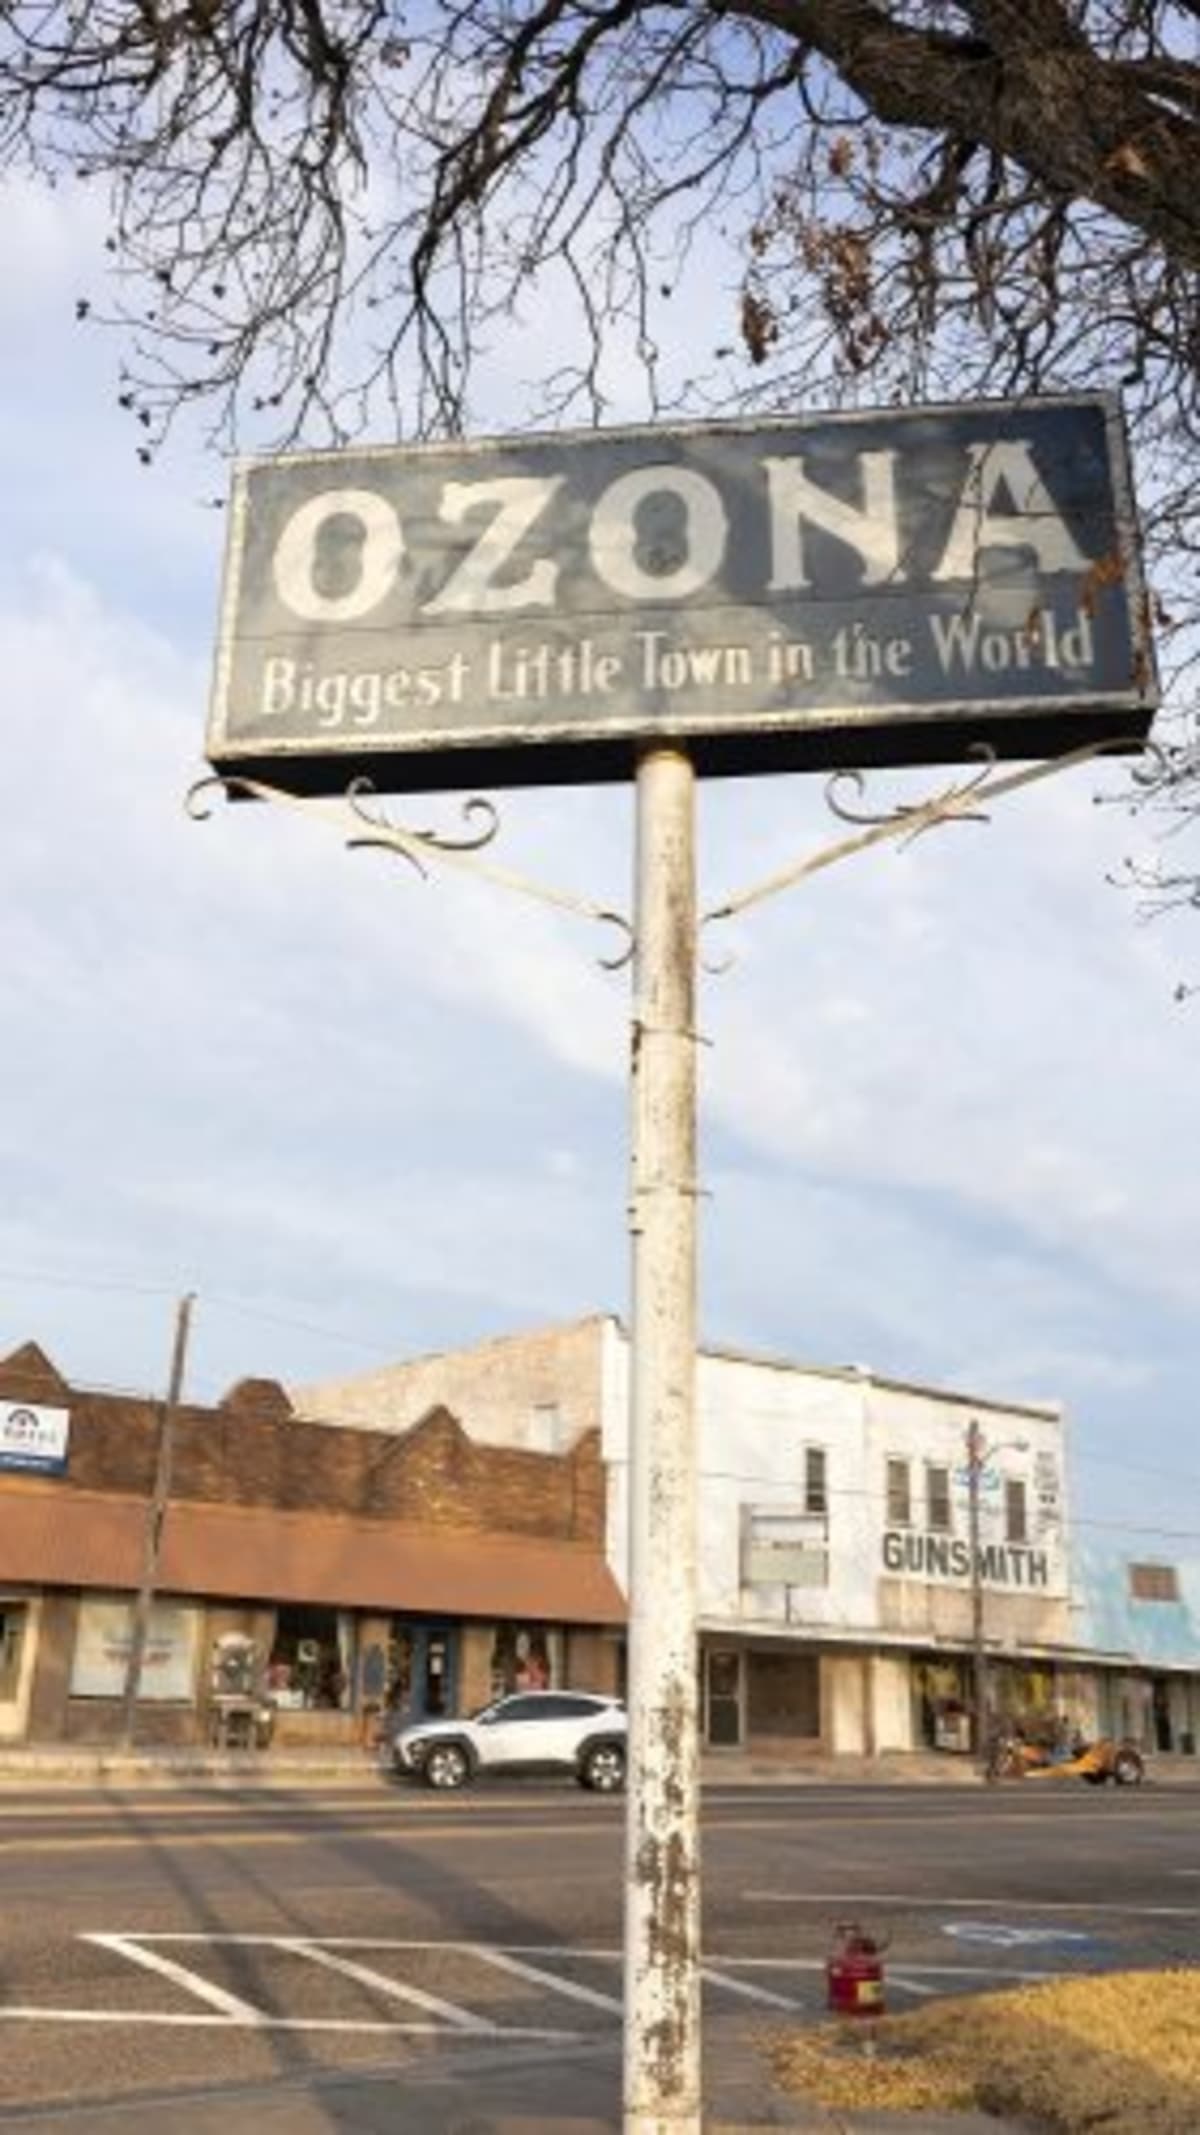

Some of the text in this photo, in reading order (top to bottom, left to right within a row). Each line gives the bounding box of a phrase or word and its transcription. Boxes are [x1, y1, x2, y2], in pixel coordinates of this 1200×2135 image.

[272, 439, 1095, 621] OZONA
[261, 606, 1094, 728] Biggest Little Town in the World
[883, 1531, 1048, 1587] GUNSMITH
